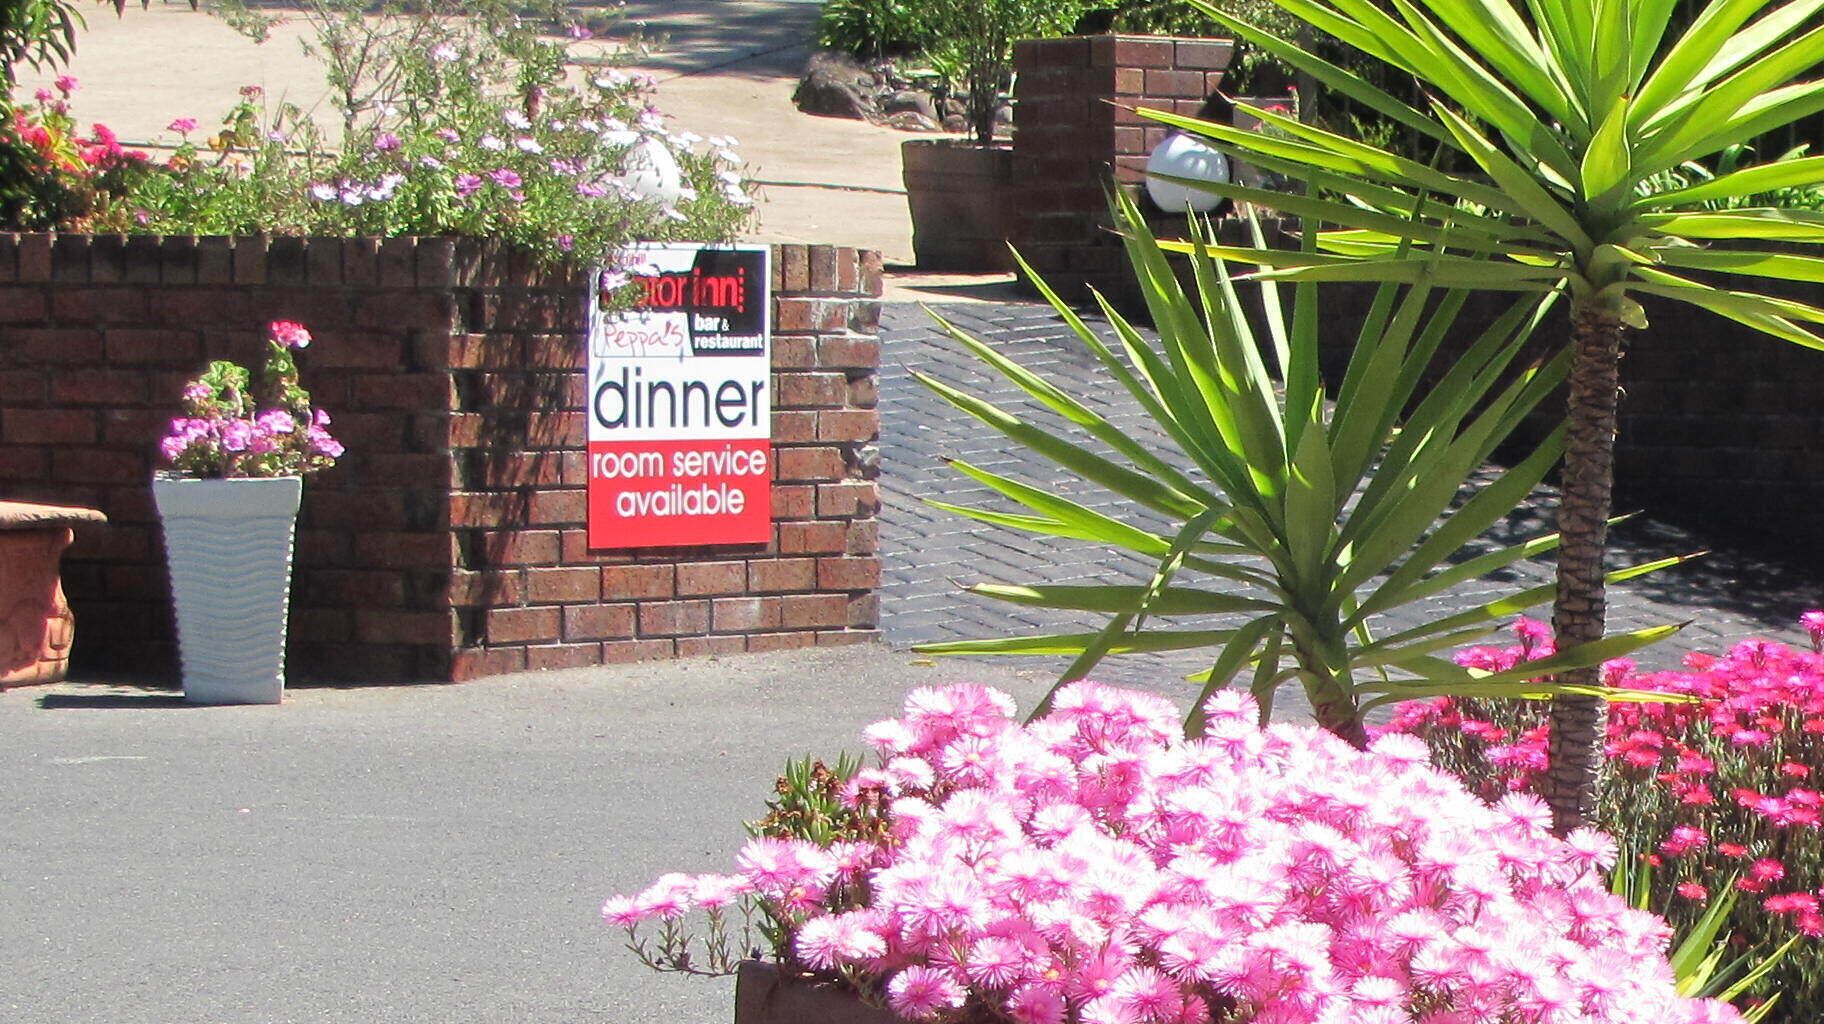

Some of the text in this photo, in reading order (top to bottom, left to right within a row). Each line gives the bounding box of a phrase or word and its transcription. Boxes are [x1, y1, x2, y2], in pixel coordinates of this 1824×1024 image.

[604, 322, 686, 356] Peppa's
[694, 313, 730, 331] bar &
[694, 333, 763, 349] restaurant
[594, 367, 765, 429] dinner
[593, 444, 766, 478] room service
[616, 483, 745, 517] available
